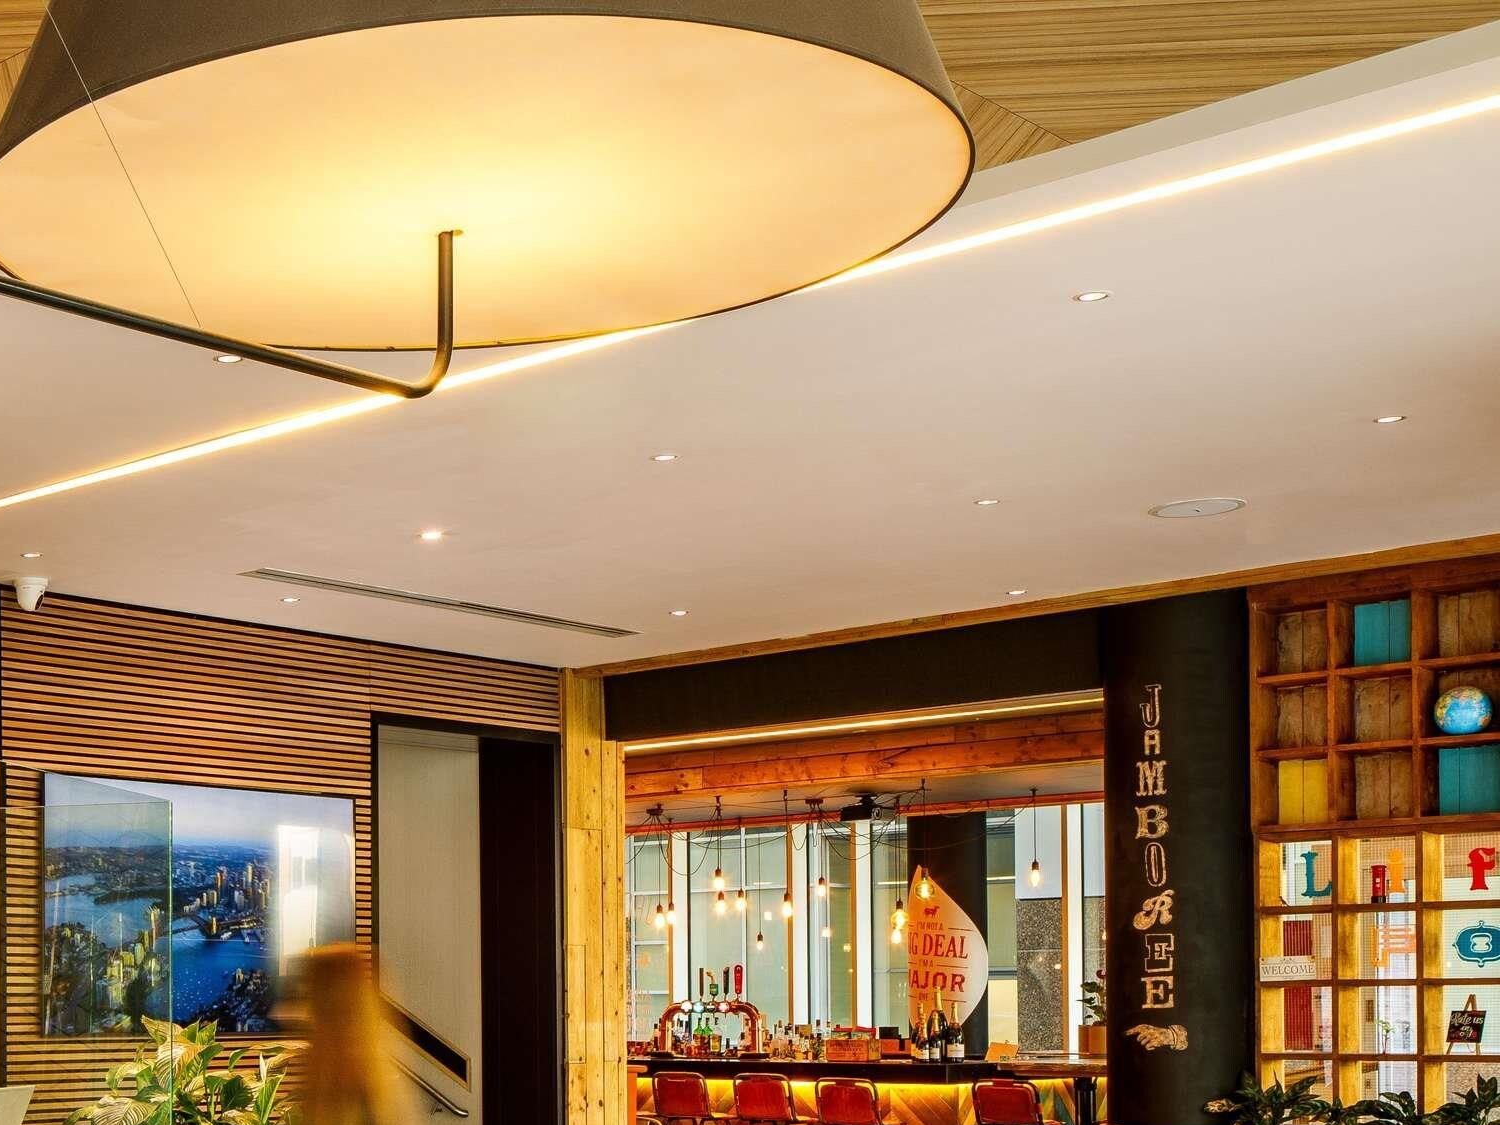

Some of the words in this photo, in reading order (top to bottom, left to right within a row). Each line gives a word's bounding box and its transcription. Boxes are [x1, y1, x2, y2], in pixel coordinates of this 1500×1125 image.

[1132, 683, 1176, 1009] JAMBOREE
[908, 931, 919, 956] IG
[922, 933, 969, 960] DEAL
[908, 969, 966, 993] AJOR
[1261, 964, 1315, 976] WELCOME
